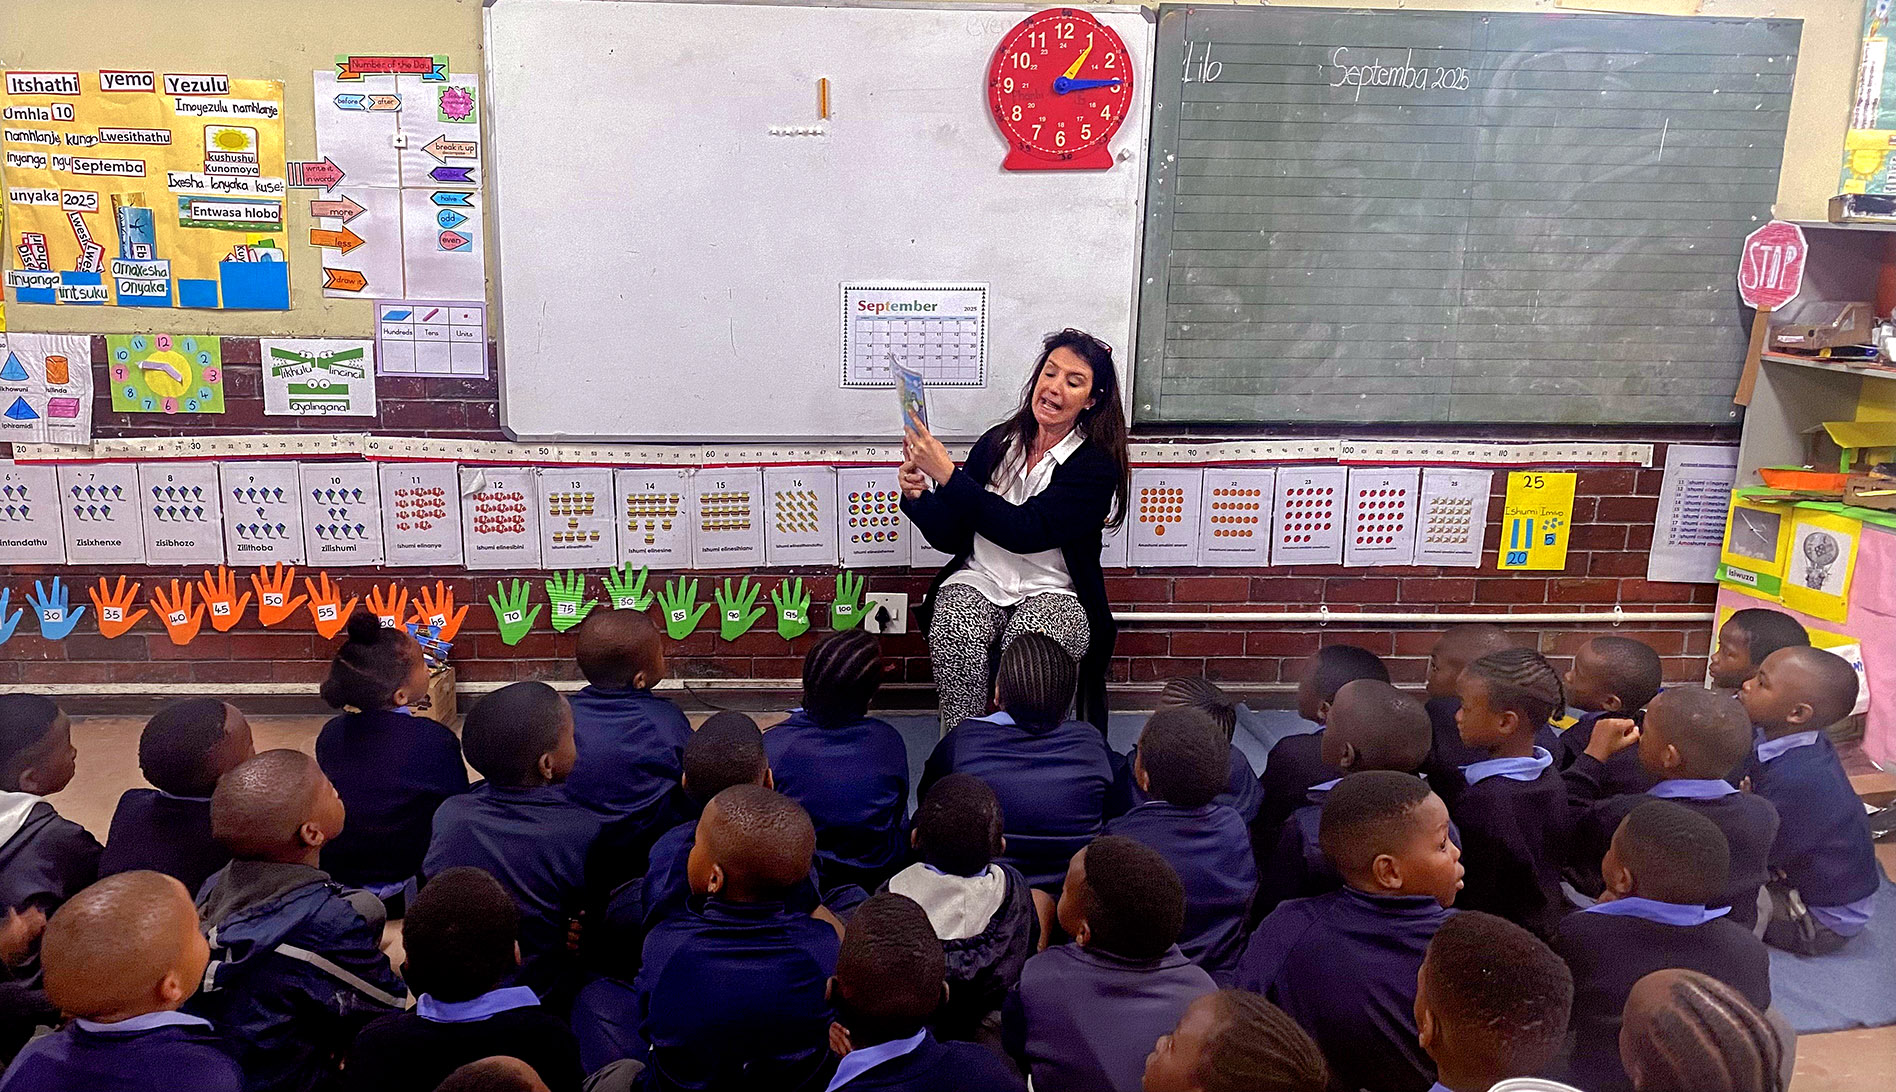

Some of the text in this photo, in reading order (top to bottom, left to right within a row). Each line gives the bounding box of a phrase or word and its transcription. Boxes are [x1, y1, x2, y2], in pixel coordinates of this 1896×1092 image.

[1055, 23, 1074, 39] 12
[1028, 32, 1046, 48] 11
[1087, 32, 1093, 46] 1
[1011, 52, 1030, 69] 10
[1104, 52, 1115, 69] 2
[352, 62, 385, 70] Number
[388, 62, 395, 70] of
[414, 62, 429, 71] Day
[1330, 46, 1469, 102] Septemba 2025
[12, 73, 228, 93] Itshathi yemo Yezulu
[1003, 77, 1014, 94] 9
[337, 97, 358, 105] before
[3, 106, 72, 120] Umhla 10
[176, 98, 278, 118] Imoyezulu namhlanje
[1012, 105, 1022, 121] 8
[1100, 105, 1111, 120] 4
[1031, 124, 1042, 140] 7
[1080, 124, 1091, 140] 5
[5, 130, 61, 146] namhlanje
[101, 131, 170, 143] Lwesithathu
[1055, 130, 1066, 147] 6
[435, 142, 457, 151] break
[459, 143, 464, 151] it
[466, 143, 475, 154] up
[7, 152, 143, 174] inyanga ngu Septemba
[208, 153, 254, 163] kushushu
[205, 164, 259, 175] Kunomoya
[168, 173, 204, 189] Ixesha
[10, 190, 96, 207] unyaka 2025
[194, 206, 279, 218] Entwasa hlobo
[330, 208, 353, 216] more
[440, 213, 455, 222] odd
[335, 237, 352, 248] less
[442, 236, 461, 244] even
[1742, 242, 1797, 290] STOP
[336, 276, 356, 284] draw
[857, 299, 938, 315] September
[383, 328, 473, 338] Hundreds Tens Units
[134, 340, 144, 349] 11
[158, 336, 170, 347] 12
[116, 351, 128, 360] 10
[200, 354, 209, 364] 2
[116, 369, 123, 380] 9
[210, 370, 217, 381] 3
[127, 389, 134, 398] 8
[200, 391, 209, 399] 4
[145, 401, 151, 409] 7
[165, 400, 172, 410] 6
[189, 400, 196, 410] 5
[866, 448, 876, 456] 70
[1498, 449, 1508, 457] 110
[5, 473, 11, 481] 6
[249, 476, 255, 484] 9
[1524, 475, 1544, 489] 25
[1505, 506, 1538, 516] Ishumi
[76, 539, 122, 547] Zisixhenxe
[1546, 533, 1555, 545] 5
[1507, 551, 1527, 565] 20
[265, 595, 281, 604] 50
[619, 598, 632, 607] 80
[104, 609, 119, 619] 35
[215, 604, 228, 613] 45
[319, 607, 334, 617] 55
[560, 605, 574, 614] 75
[44, 610, 60, 621] 30
[169, 612, 185, 623] 40
[505, 612, 518, 622] 70
[673, 611, 685, 620] 85
